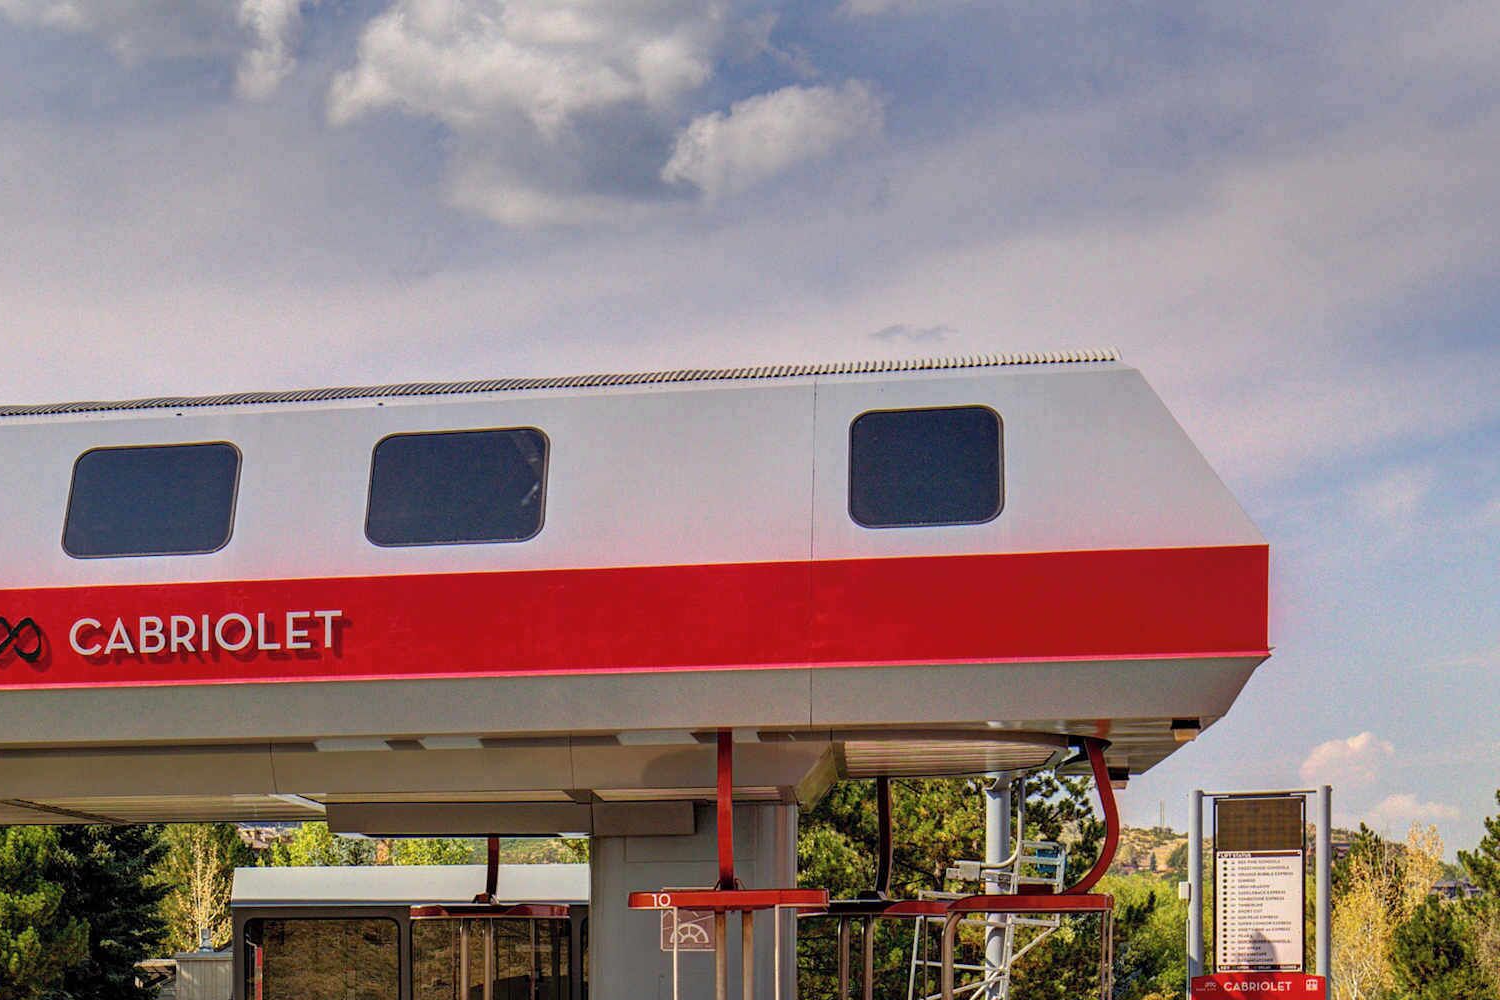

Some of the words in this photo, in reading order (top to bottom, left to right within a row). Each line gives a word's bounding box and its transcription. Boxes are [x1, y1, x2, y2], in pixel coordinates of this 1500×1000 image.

[69, 610, 342, 656] CABRIOLET
[652, 893, 671, 907] 10
[1223, 981, 1292, 991] CABRIOLET
